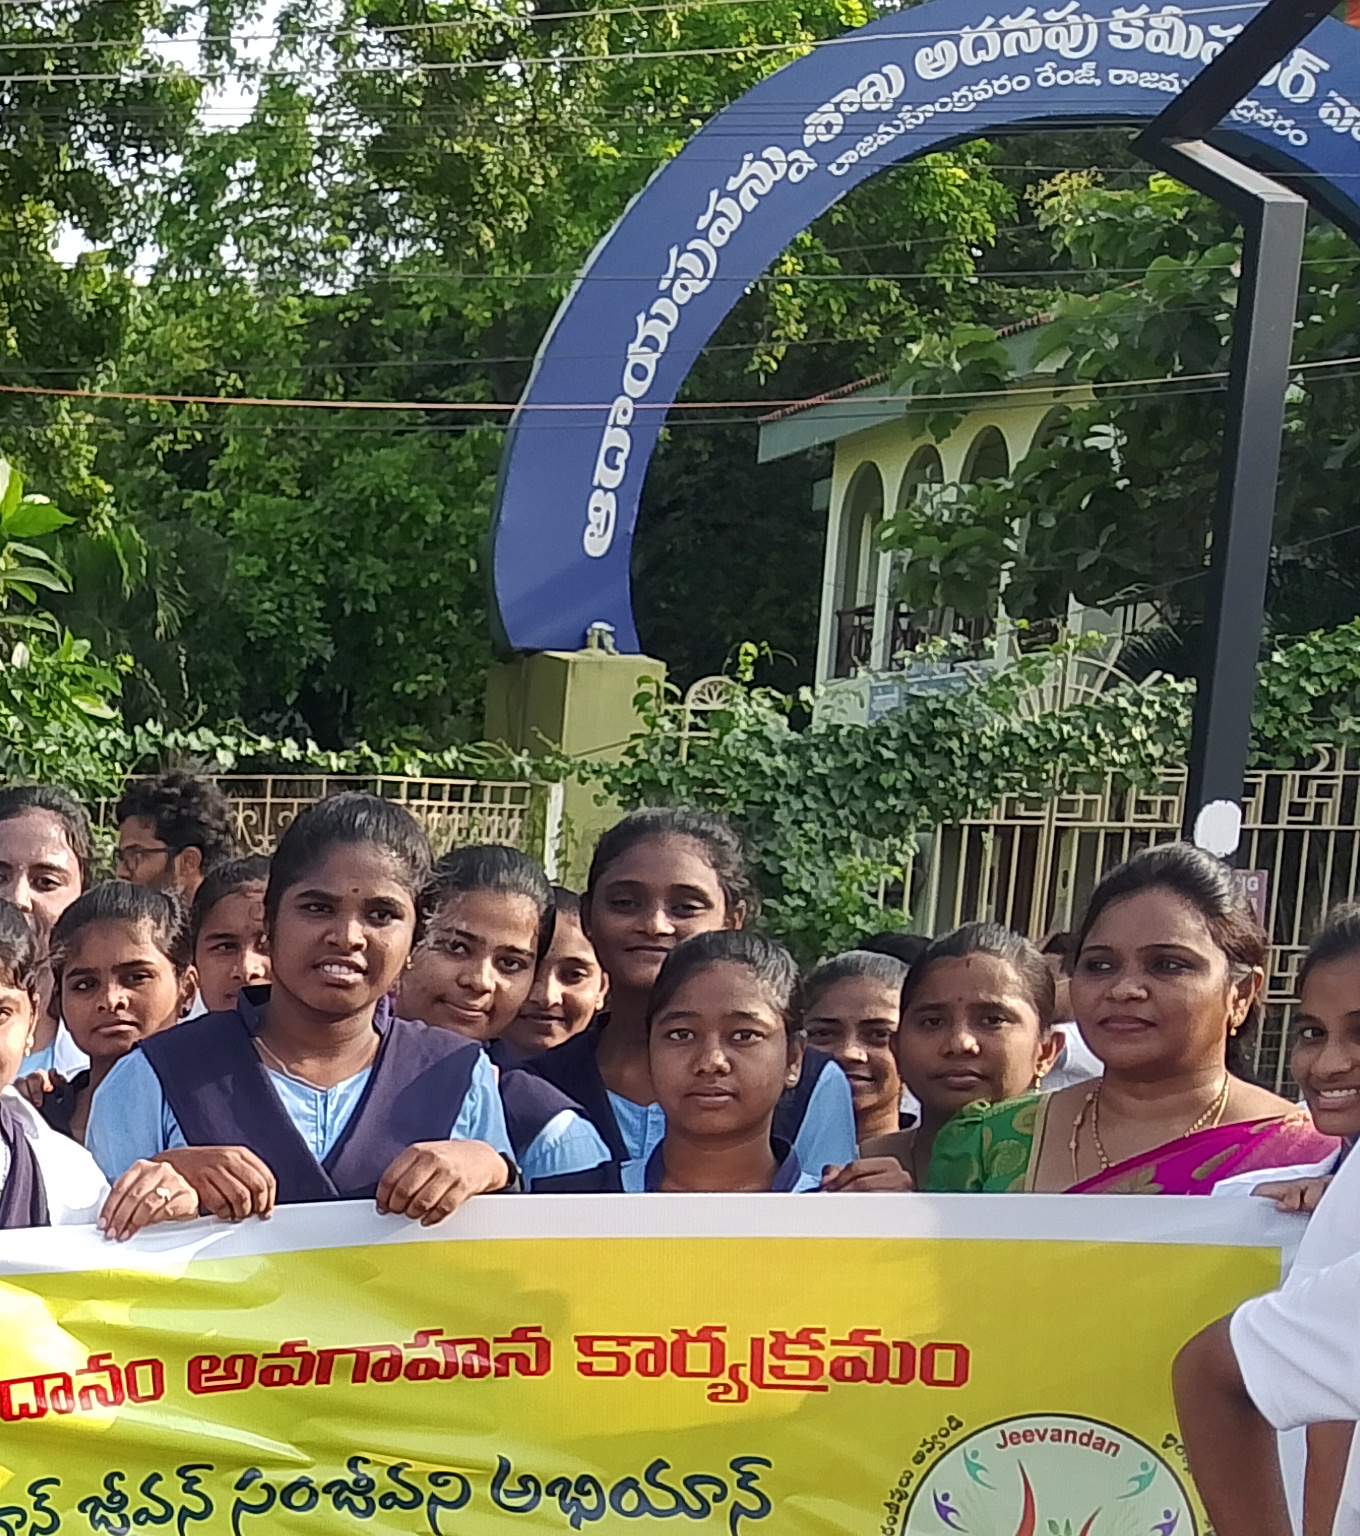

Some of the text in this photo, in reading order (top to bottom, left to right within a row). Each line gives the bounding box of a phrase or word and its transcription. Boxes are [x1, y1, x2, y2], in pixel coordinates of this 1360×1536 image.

[187, 1325, 552, 1396] అవగాహన
[573, 1325, 971, 1404] కార్యక్రమం
[996, 1426, 1121, 1458] Jeevandan
